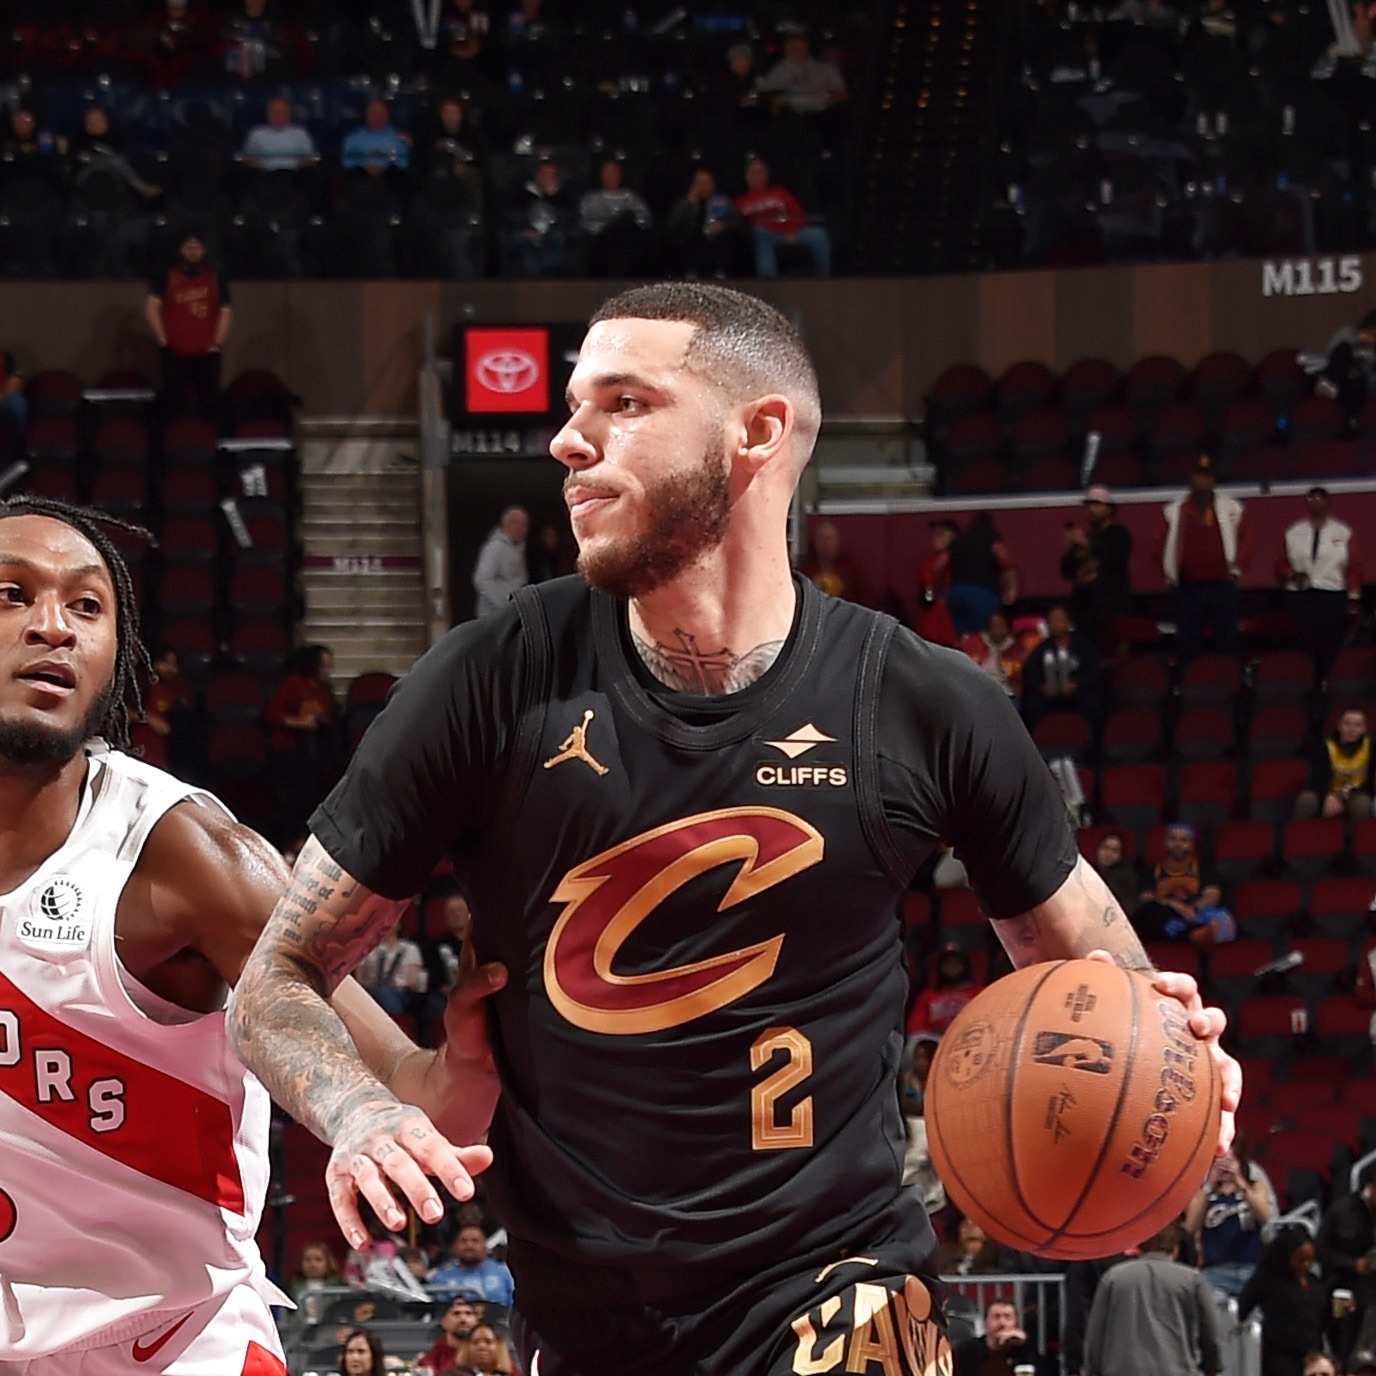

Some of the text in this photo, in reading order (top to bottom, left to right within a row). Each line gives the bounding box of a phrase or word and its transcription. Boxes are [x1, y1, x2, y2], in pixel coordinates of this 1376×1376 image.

[1262, 256, 1363, 297] M115
[755, 766, 848, 787] CLIFFS
[21, 921, 86, 941] Sun Life
[543, 805, 825, 1035] C
[750, 1025, 814, 1150] 2
